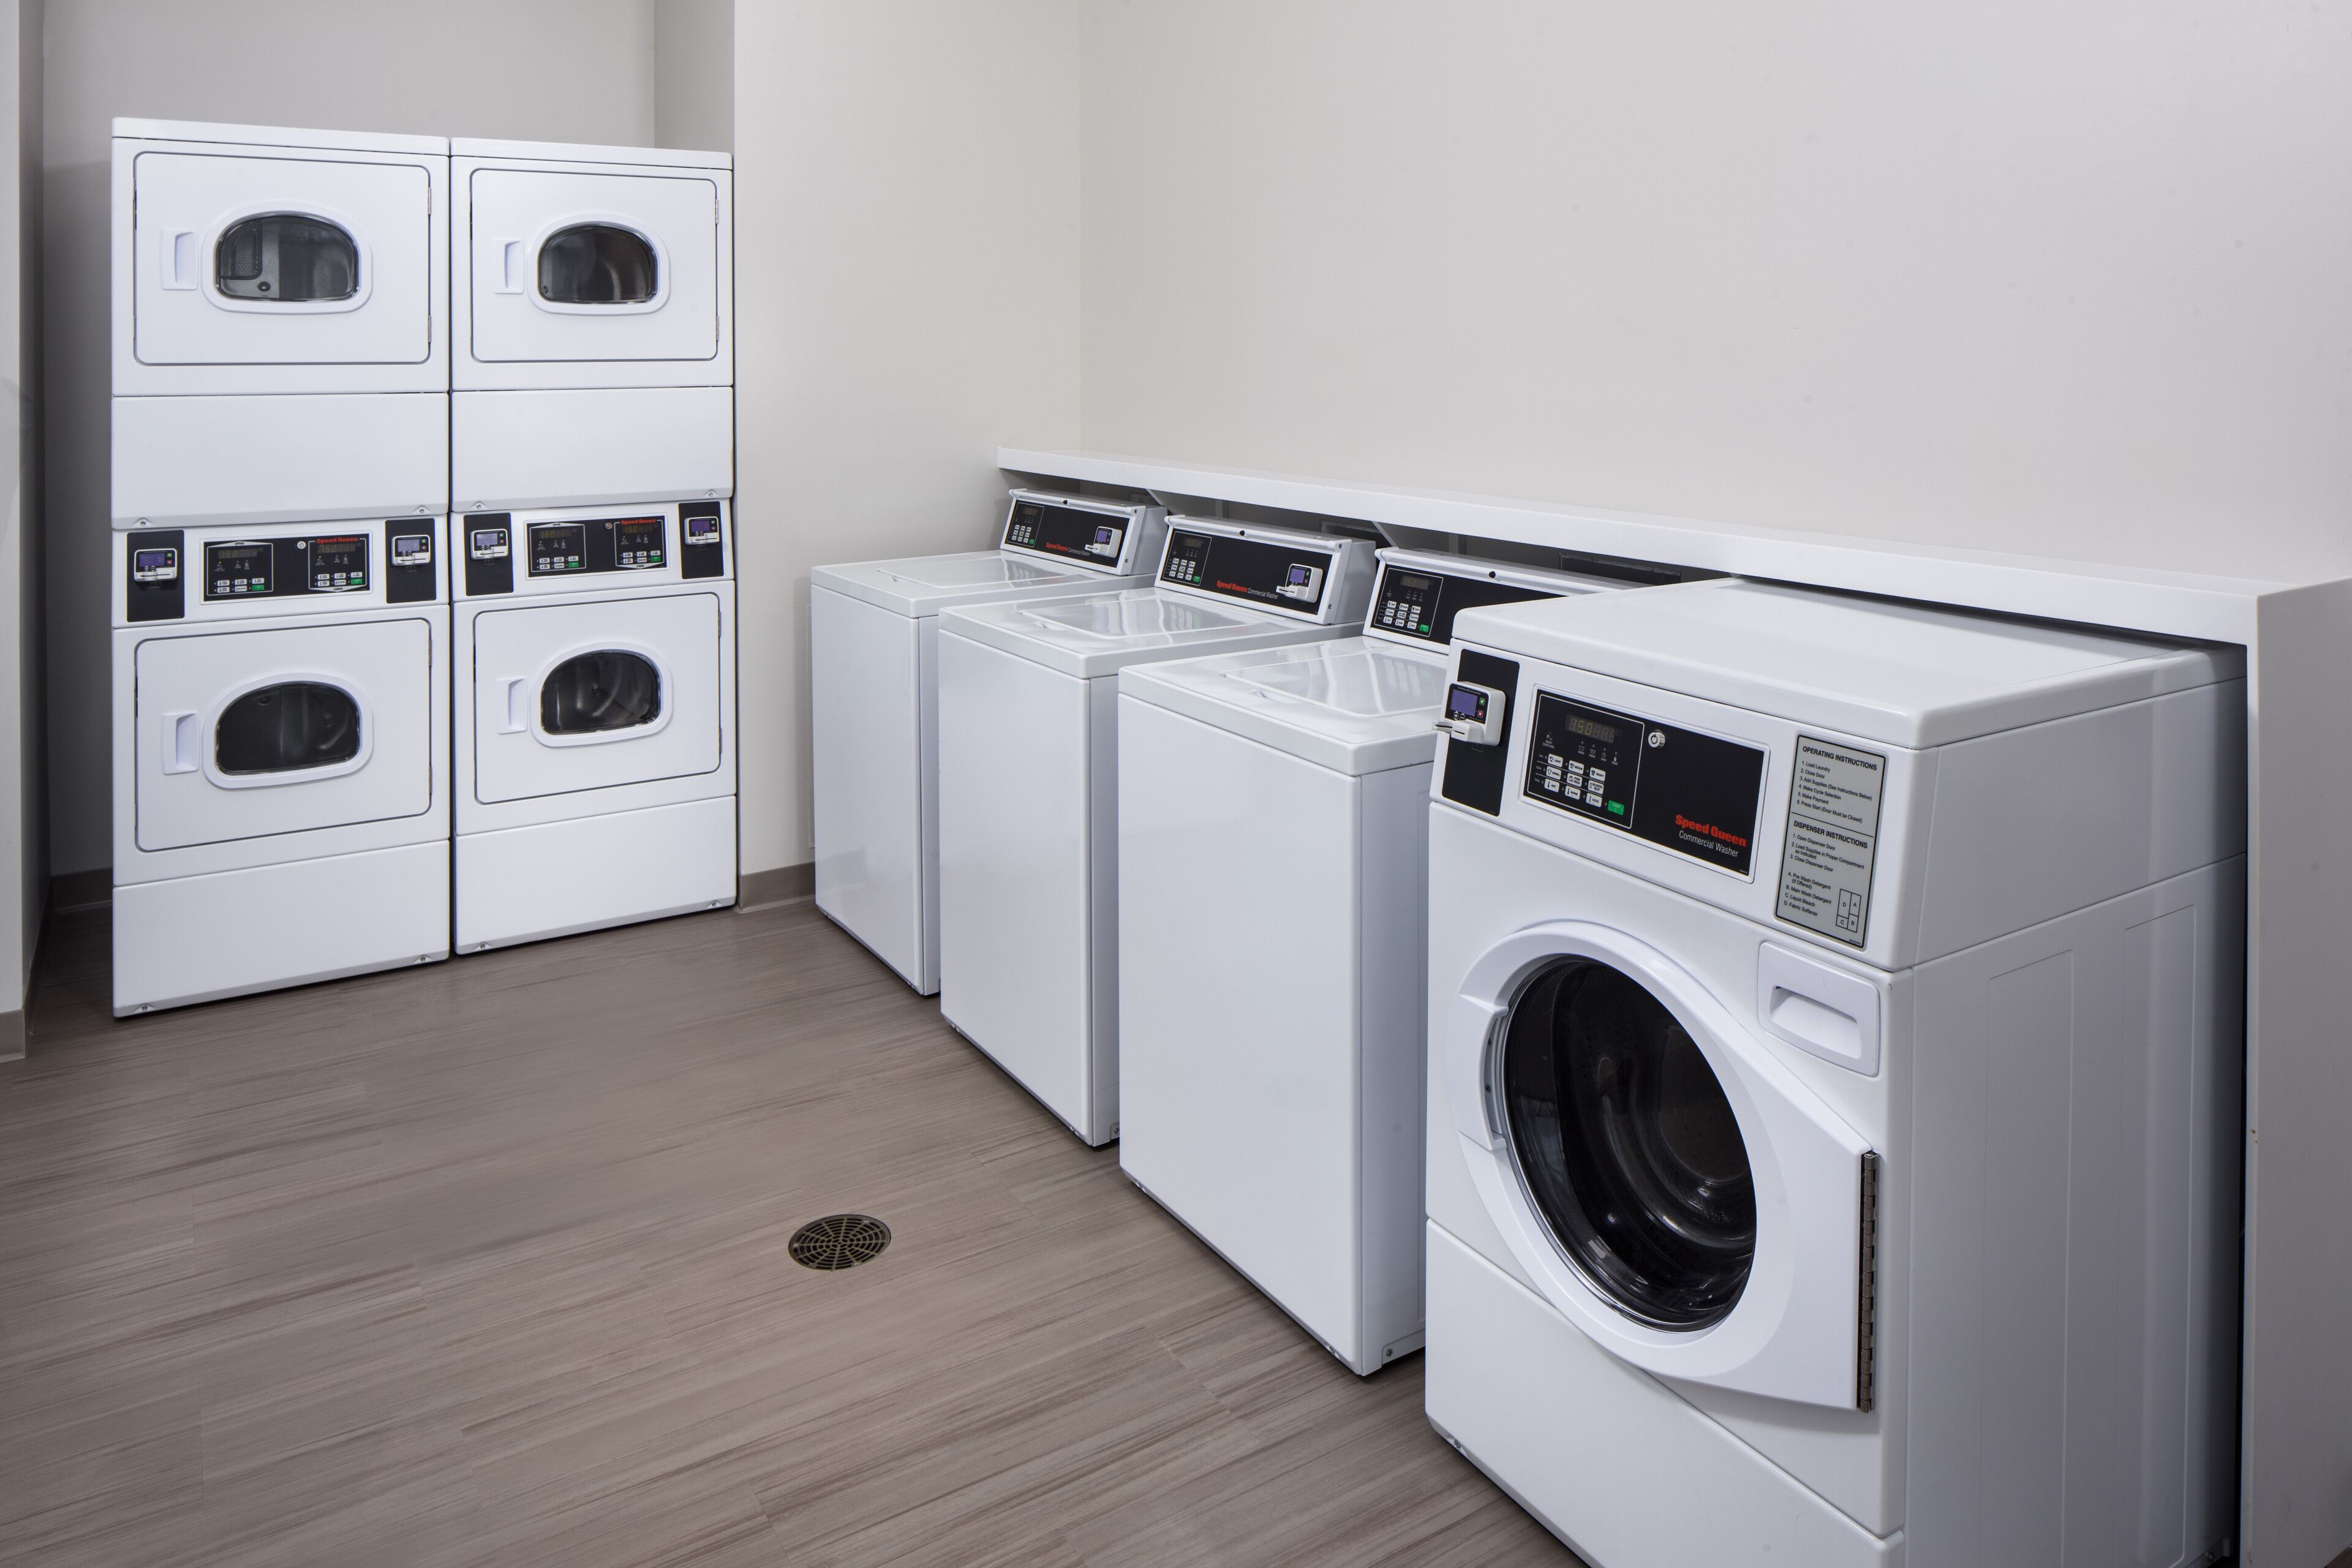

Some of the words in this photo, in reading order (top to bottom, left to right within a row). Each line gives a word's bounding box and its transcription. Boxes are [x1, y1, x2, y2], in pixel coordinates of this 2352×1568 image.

[1232, 583, 1248, 593] Queen
[1248, 588, 1266, 597] Commercial
[1266, 591, 1278, 599] Washer
[1803, 746, 1834, 759] OPERATING
[1835, 754, 1877, 771] INSTRUCTIONS
[1816, 764, 1830, 773] Laundry
[1812, 780, 1827, 788] Supplies
[1838, 787, 1858, 796] Instructions
[1859, 793, 1872, 801] Below)
[1824, 791, 1841, 800] Selection
[1813, 796, 1829, 805] Payment
[1848, 815, 1862, 824] Closed)
[1676, 814, 1709, 834] Speed
[1711, 826, 1746, 847] Queen
[1794, 820, 1825, 836] DISPENSER
[1826, 831, 1868, 849] INSTRUCTIONS
[1679, 830, 1714, 849] Commercial
[1715, 842, 1738, 857] Washer
[1807, 838, 1826, 847] Dispenser
[1800, 851, 1817, 860] Indicated
[1805, 846, 1821, 855] Supplies
[1826, 853, 1838, 861] Proper
[1839, 857, 1864, 869] Compartment
[1805, 859, 1824, 869] Dispenser
[1797, 880, 1812, 890] Offered)
[1812, 880, 1831, 890] Detergent
[1802, 898, 1815, 907] Bleach
[1813, 894, 1831, 904] Detergent
[1801, 907, 1818, 916] Softener
